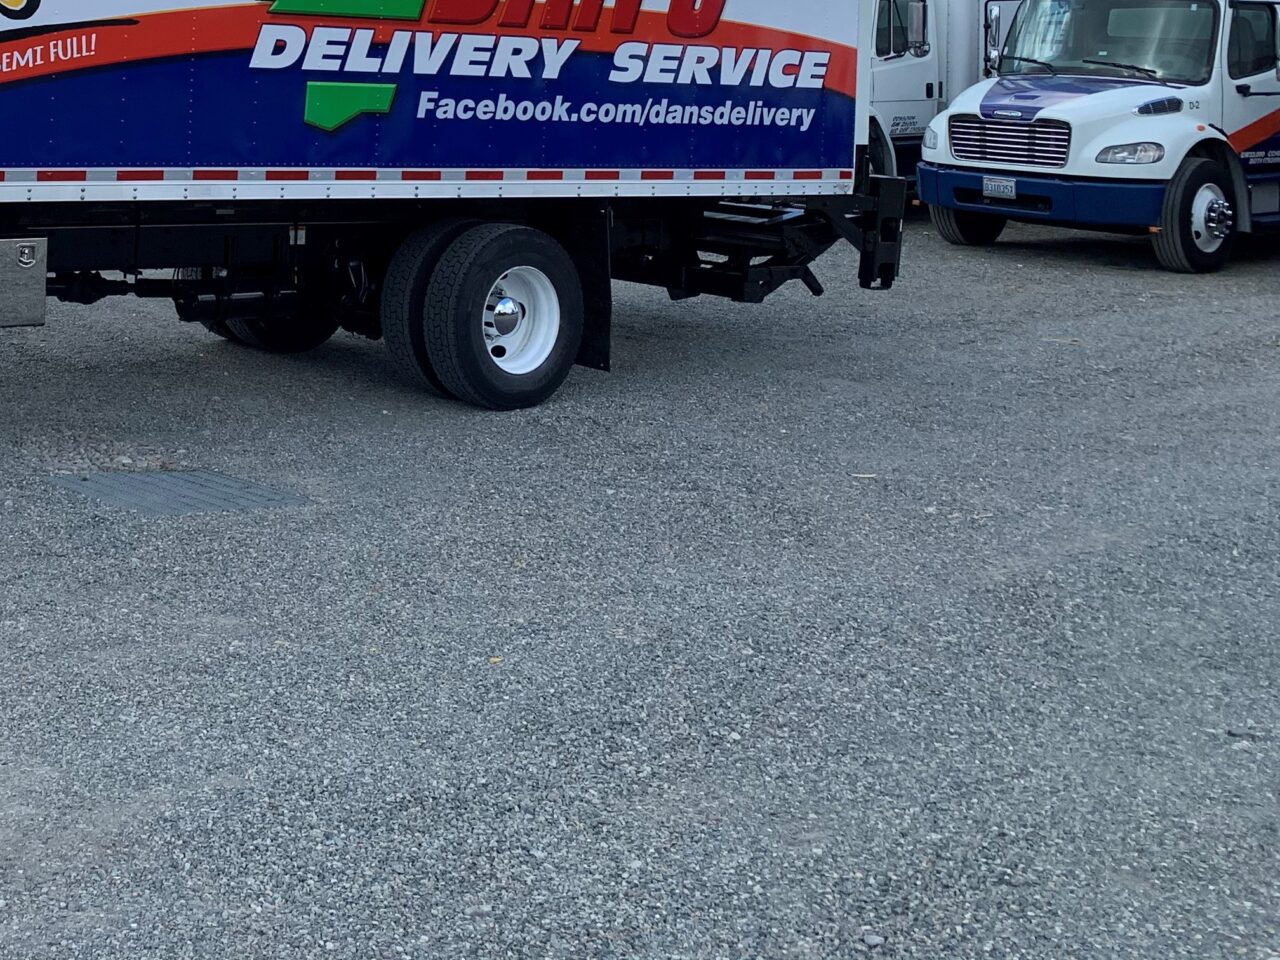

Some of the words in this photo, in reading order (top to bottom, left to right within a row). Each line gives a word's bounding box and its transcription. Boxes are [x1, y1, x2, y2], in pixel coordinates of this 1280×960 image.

[49, 33, 97, 63] FULL!
[249, 23, 581, 80] DELIVERY
[608, 43, 832, 89] SERVICE
[416, 91, 816, 132] Facebook.com/dansdelivery
[1189, 100, 1200, 110] D-2
